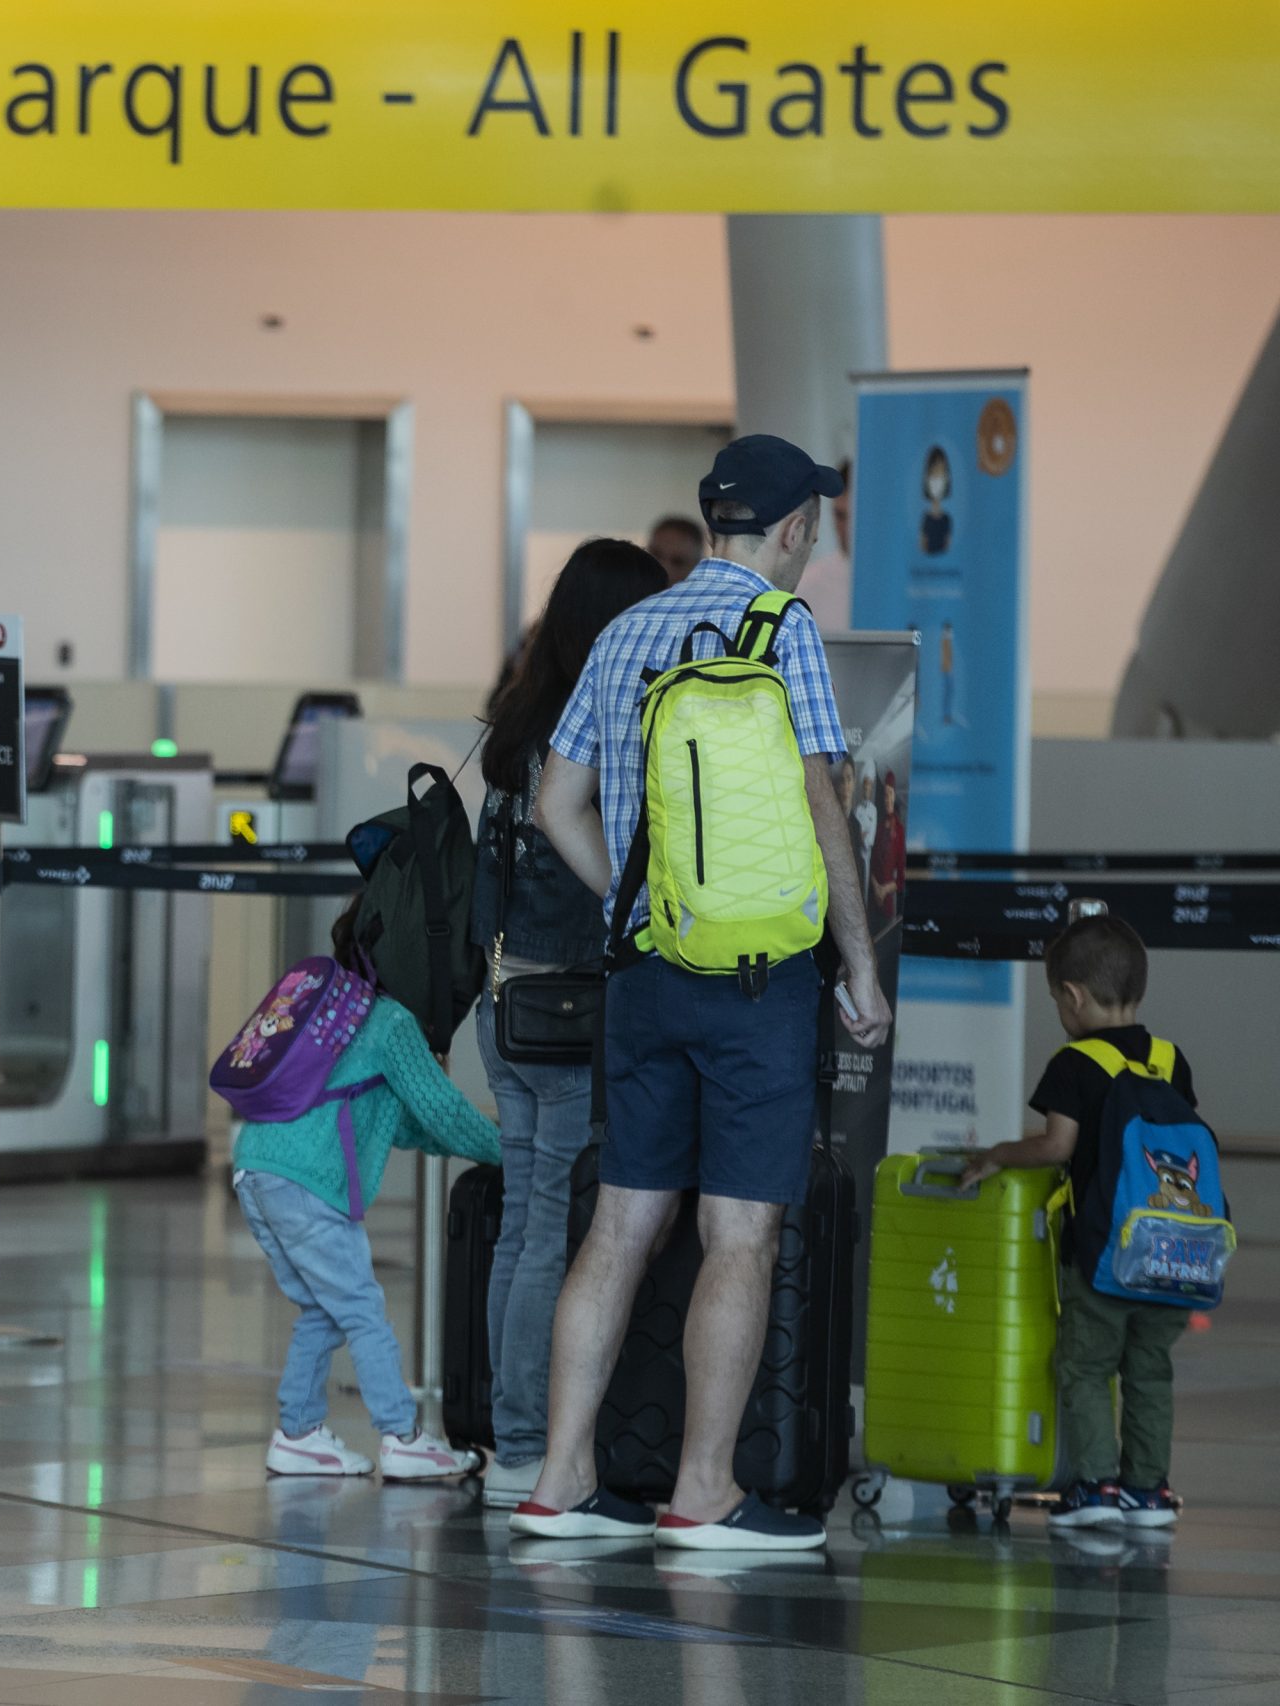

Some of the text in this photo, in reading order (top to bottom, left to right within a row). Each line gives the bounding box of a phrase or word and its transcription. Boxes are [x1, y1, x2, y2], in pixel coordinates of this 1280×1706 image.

[382, 93, 415, 104] -
[466, 30, 620, 138] All
[673, 35, 1011, 139] Gates
[852, 1053, 874, 1073] CLASS
[1151, 1234, 1215, 1265] PAW
[1147, 1257, 1211, 1283] PATROL
